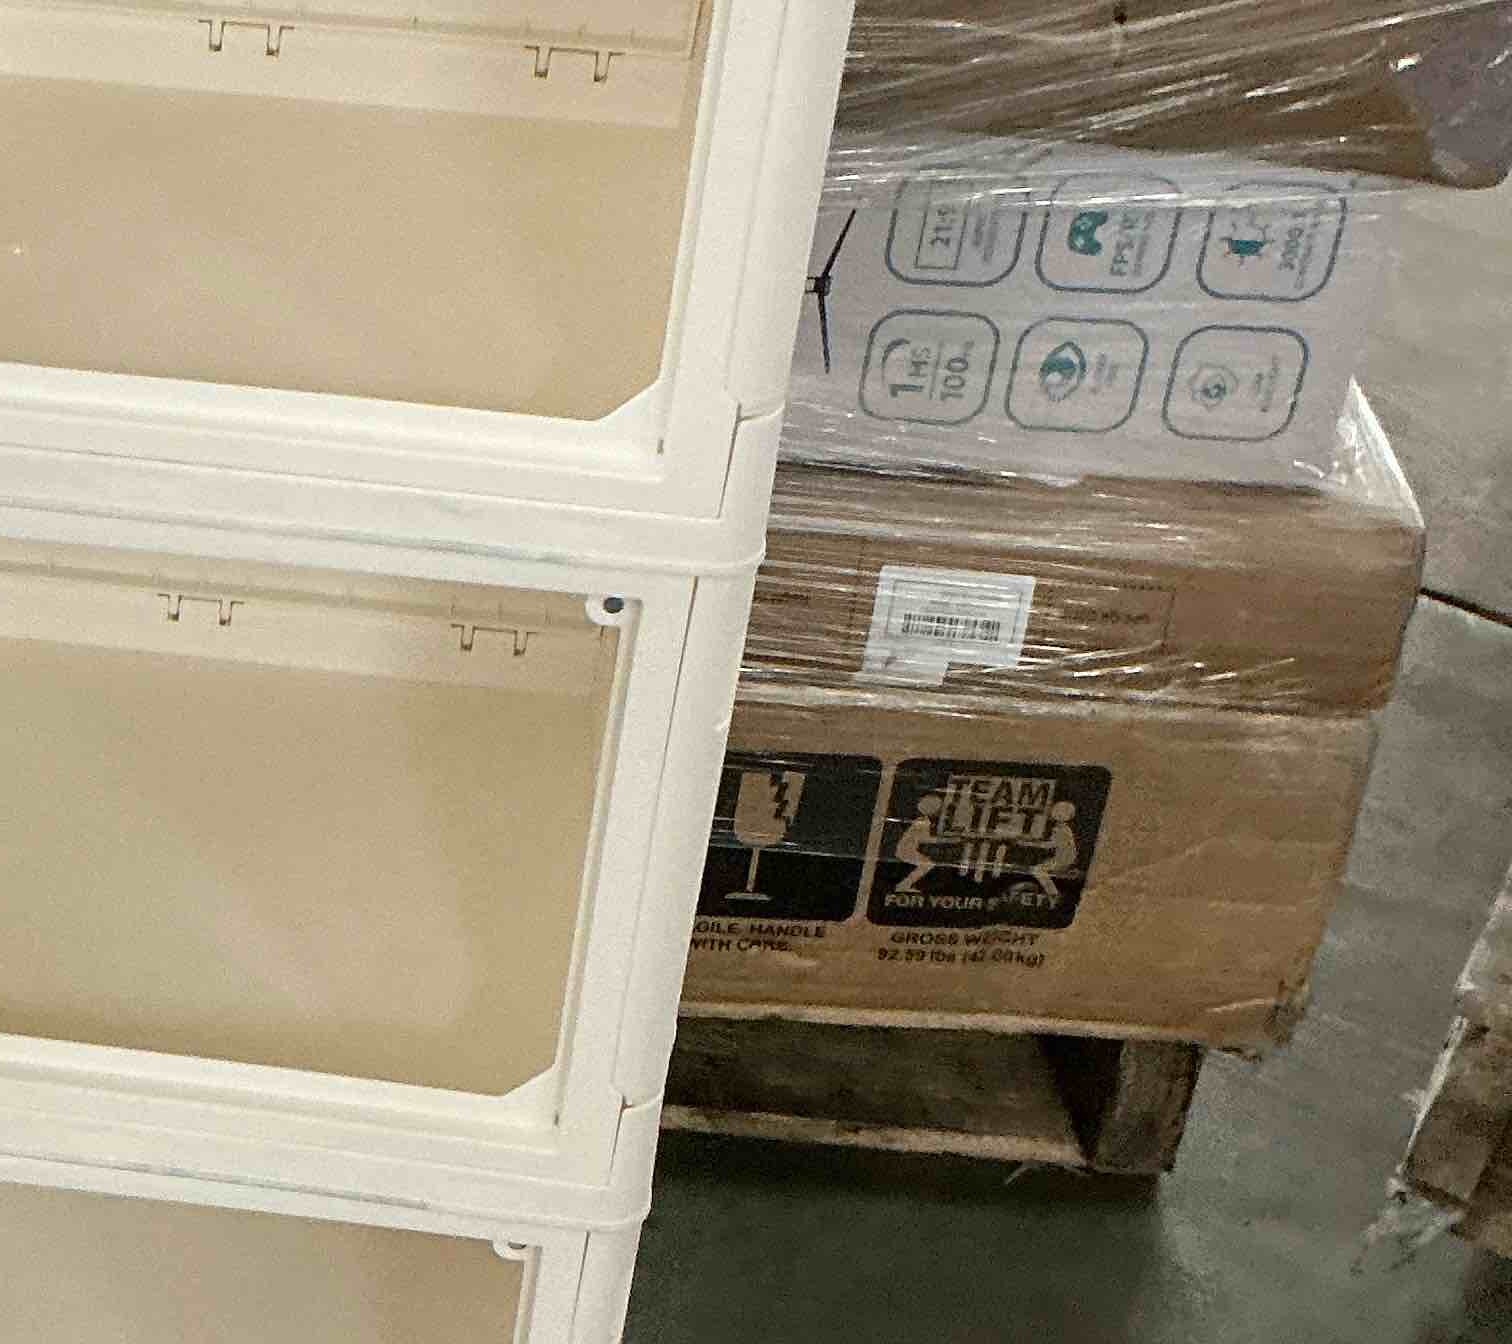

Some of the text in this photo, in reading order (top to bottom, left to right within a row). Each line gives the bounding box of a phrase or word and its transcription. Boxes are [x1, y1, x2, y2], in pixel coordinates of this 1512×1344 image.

[948, 778, 1052, 806] TEAM
[943, 806, 1048, 836] LIFT
[884, 895, 925, 908] FOR
[929, 896, 984, 911] YOUR
[749, 923, 826, 938] HANDLE
[890, 931, 959, 946] GROSS
